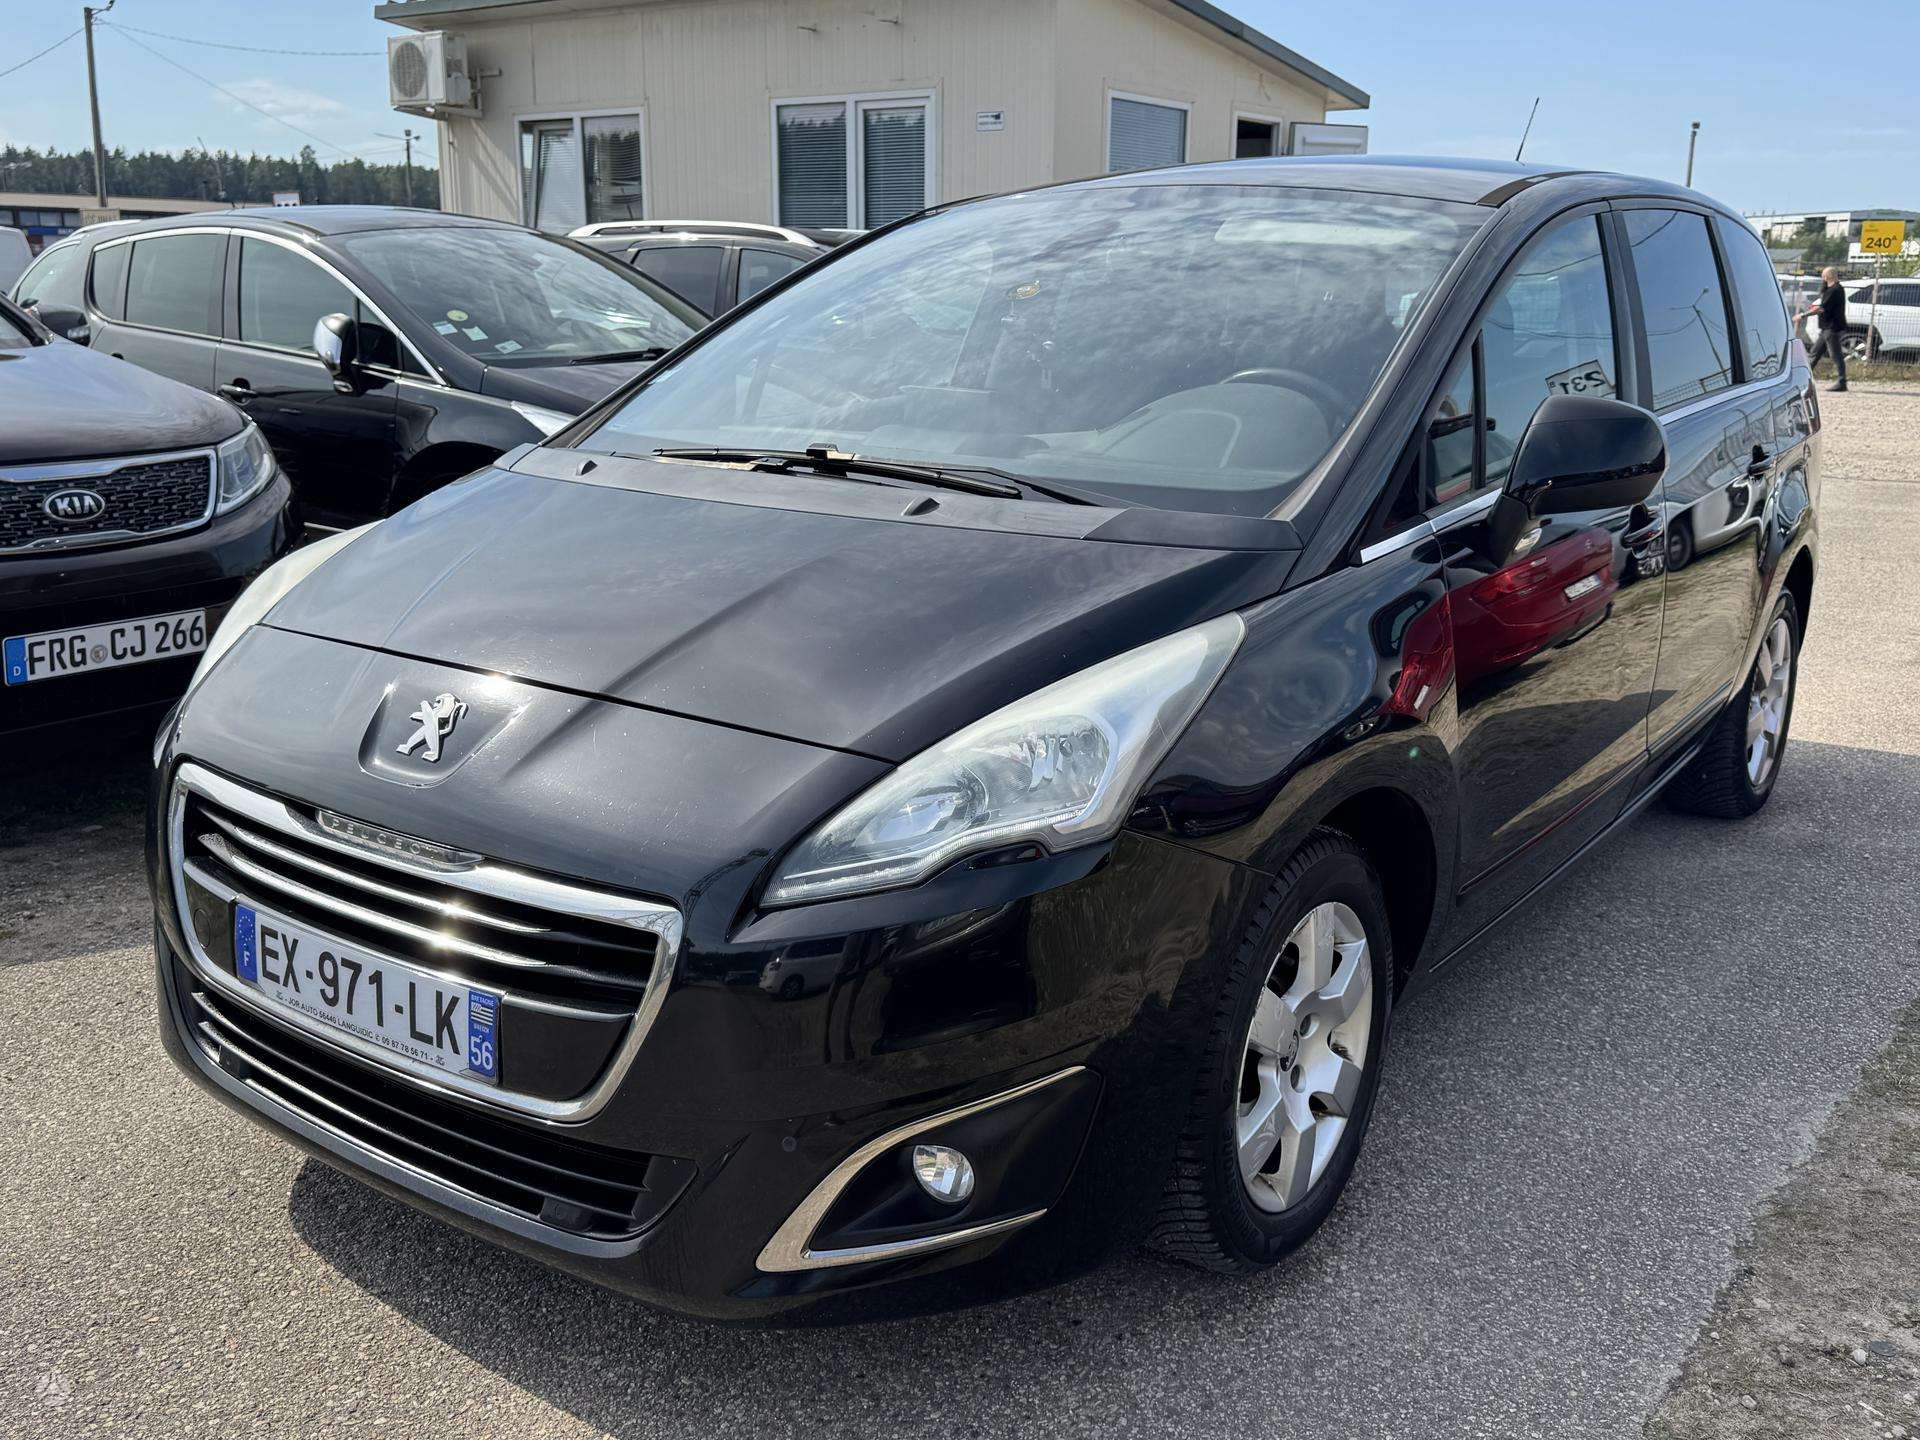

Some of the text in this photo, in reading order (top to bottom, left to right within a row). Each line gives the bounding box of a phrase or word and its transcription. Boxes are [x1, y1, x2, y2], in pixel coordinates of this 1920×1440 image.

[54, 495, 99, 516] KIA
[27, 615, 204, 675] FRG CJ 266
[13, 665, 21, 677] D
[244, 950, 250, 967] F
[260, 924, 461, 1056] EX-971-LK
[301, 1003, 318, 1016] AUTO
[337, 1018, 373, 1038] LANGUIDIC
[471, 1036, 493, 1070] 56
